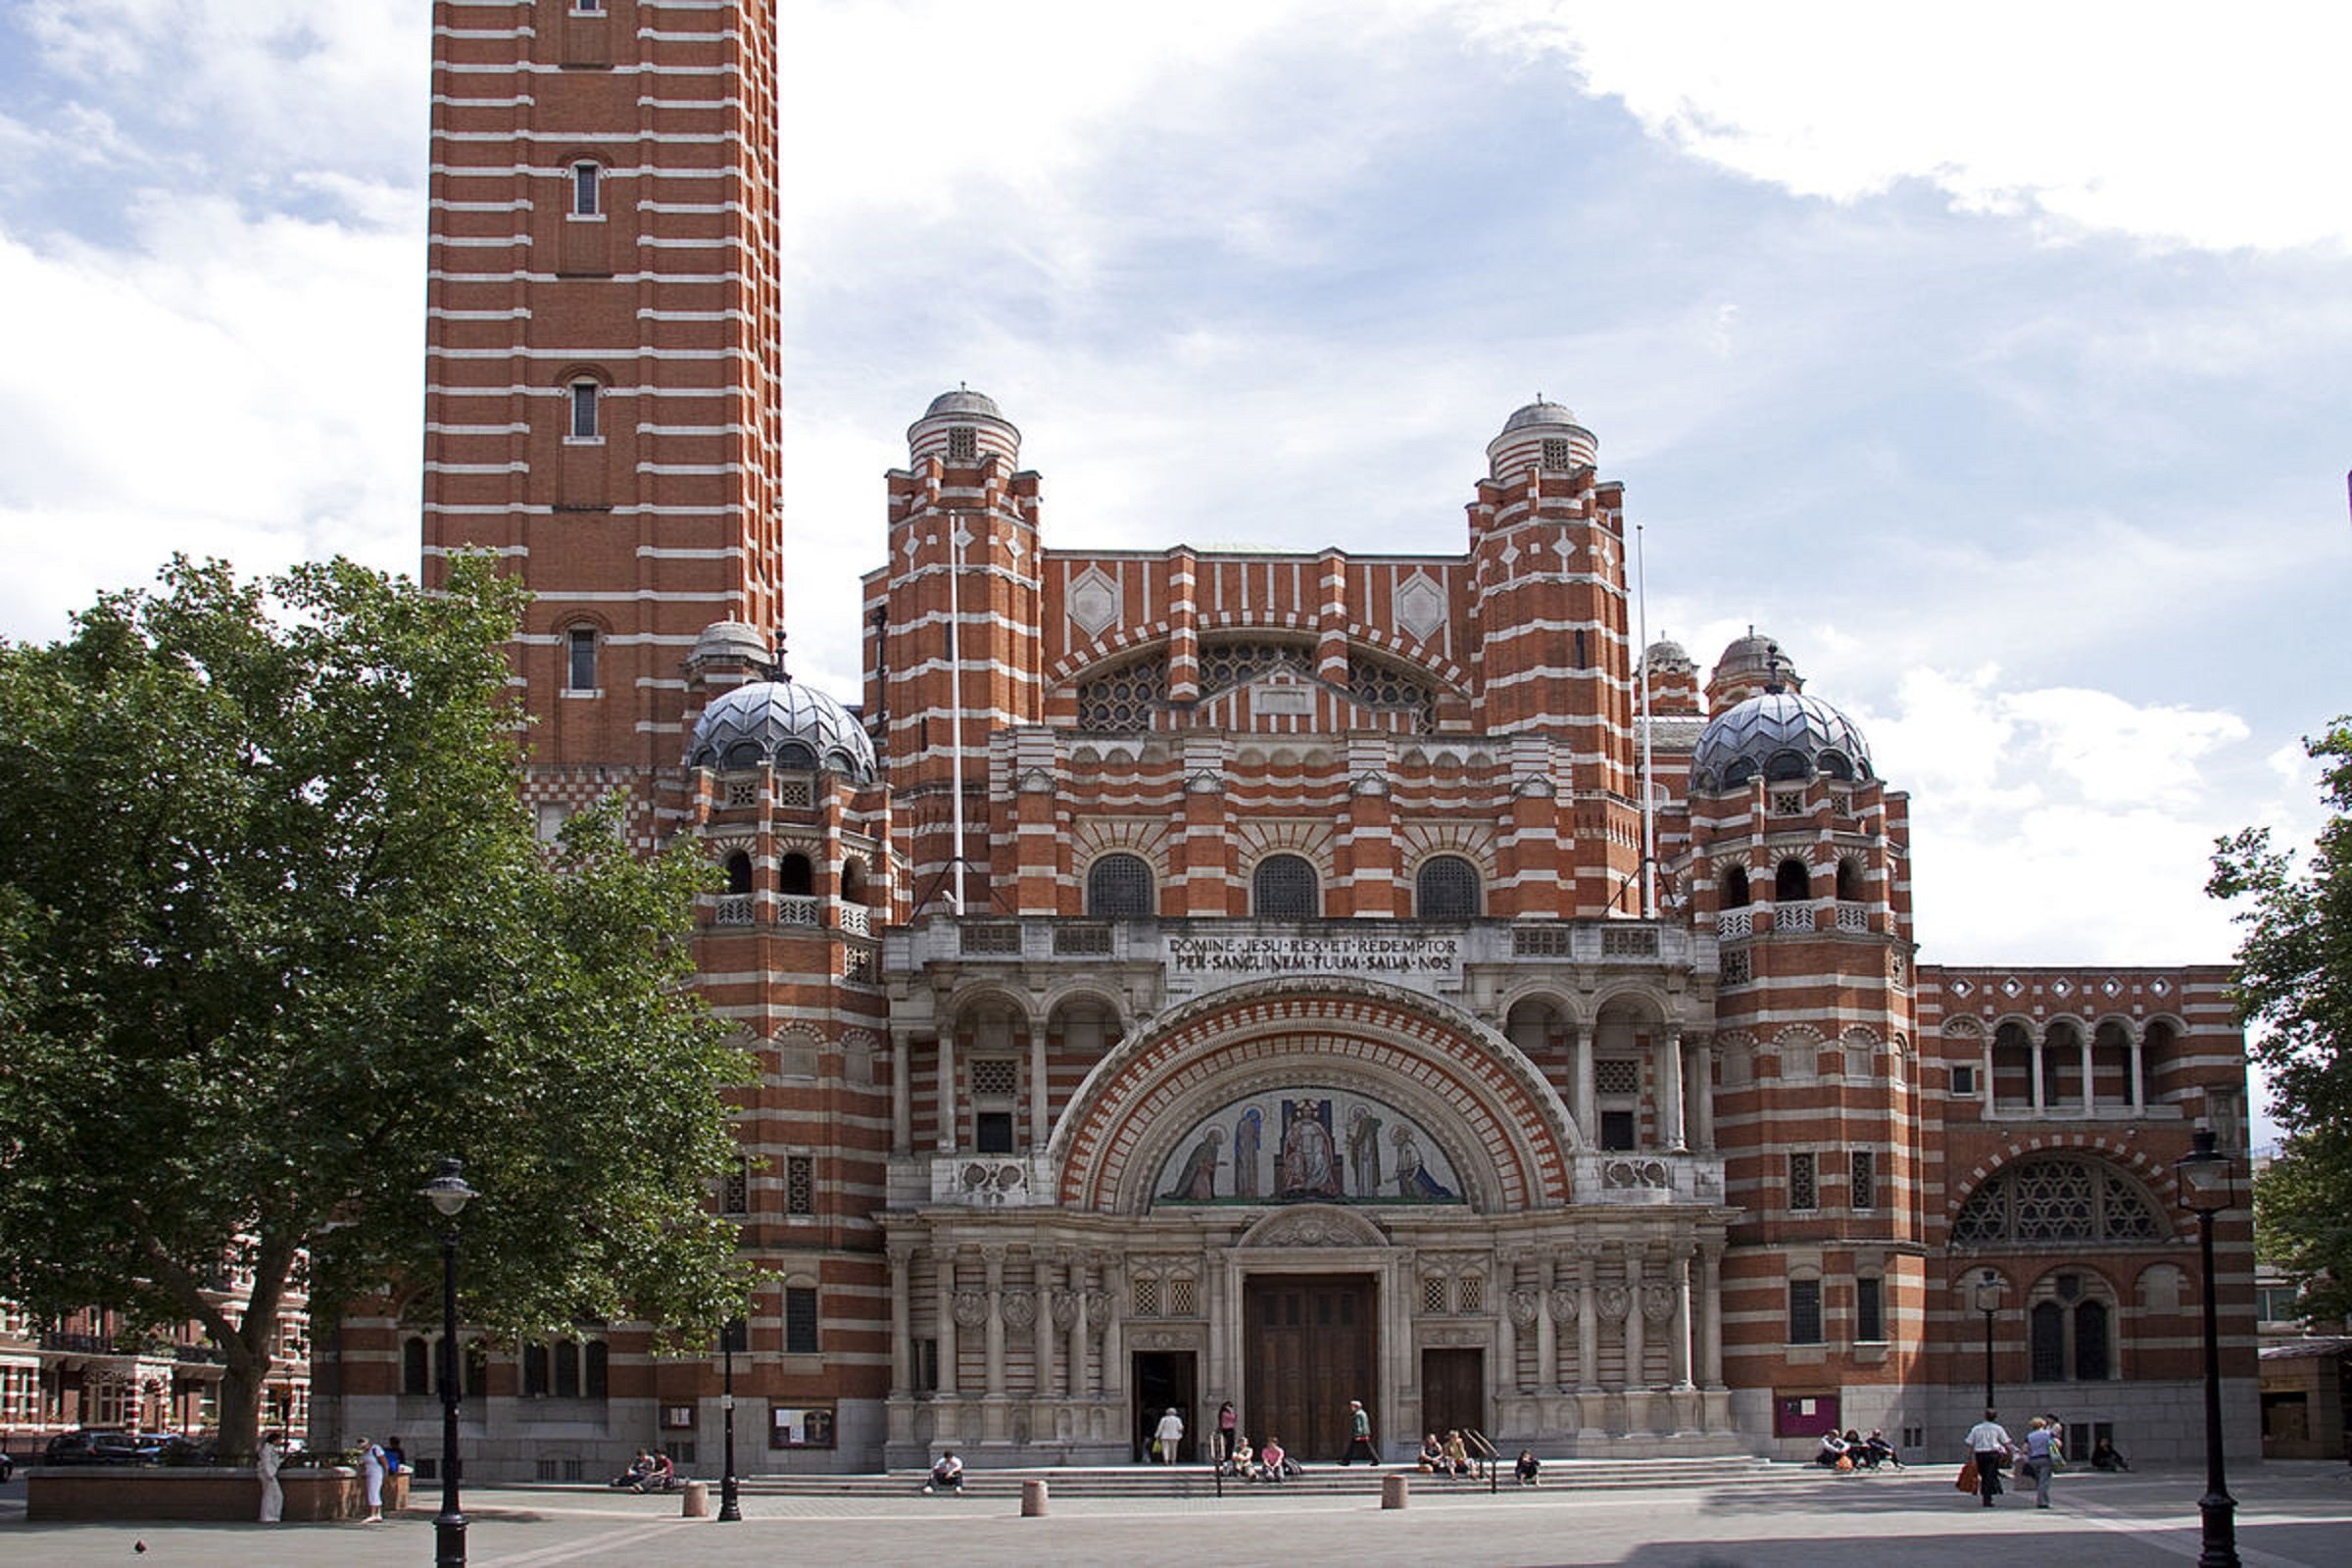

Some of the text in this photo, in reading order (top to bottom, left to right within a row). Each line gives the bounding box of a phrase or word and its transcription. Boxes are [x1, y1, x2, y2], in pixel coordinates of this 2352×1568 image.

[1169, 939, 1457, 953] DOMINE JESU REX ET REDEMPTOR
[1176, 956, 1206, 970] PER
[1312, 955, 1358, 970] TUUM
[1418, 956, 1452, 970] NOS
